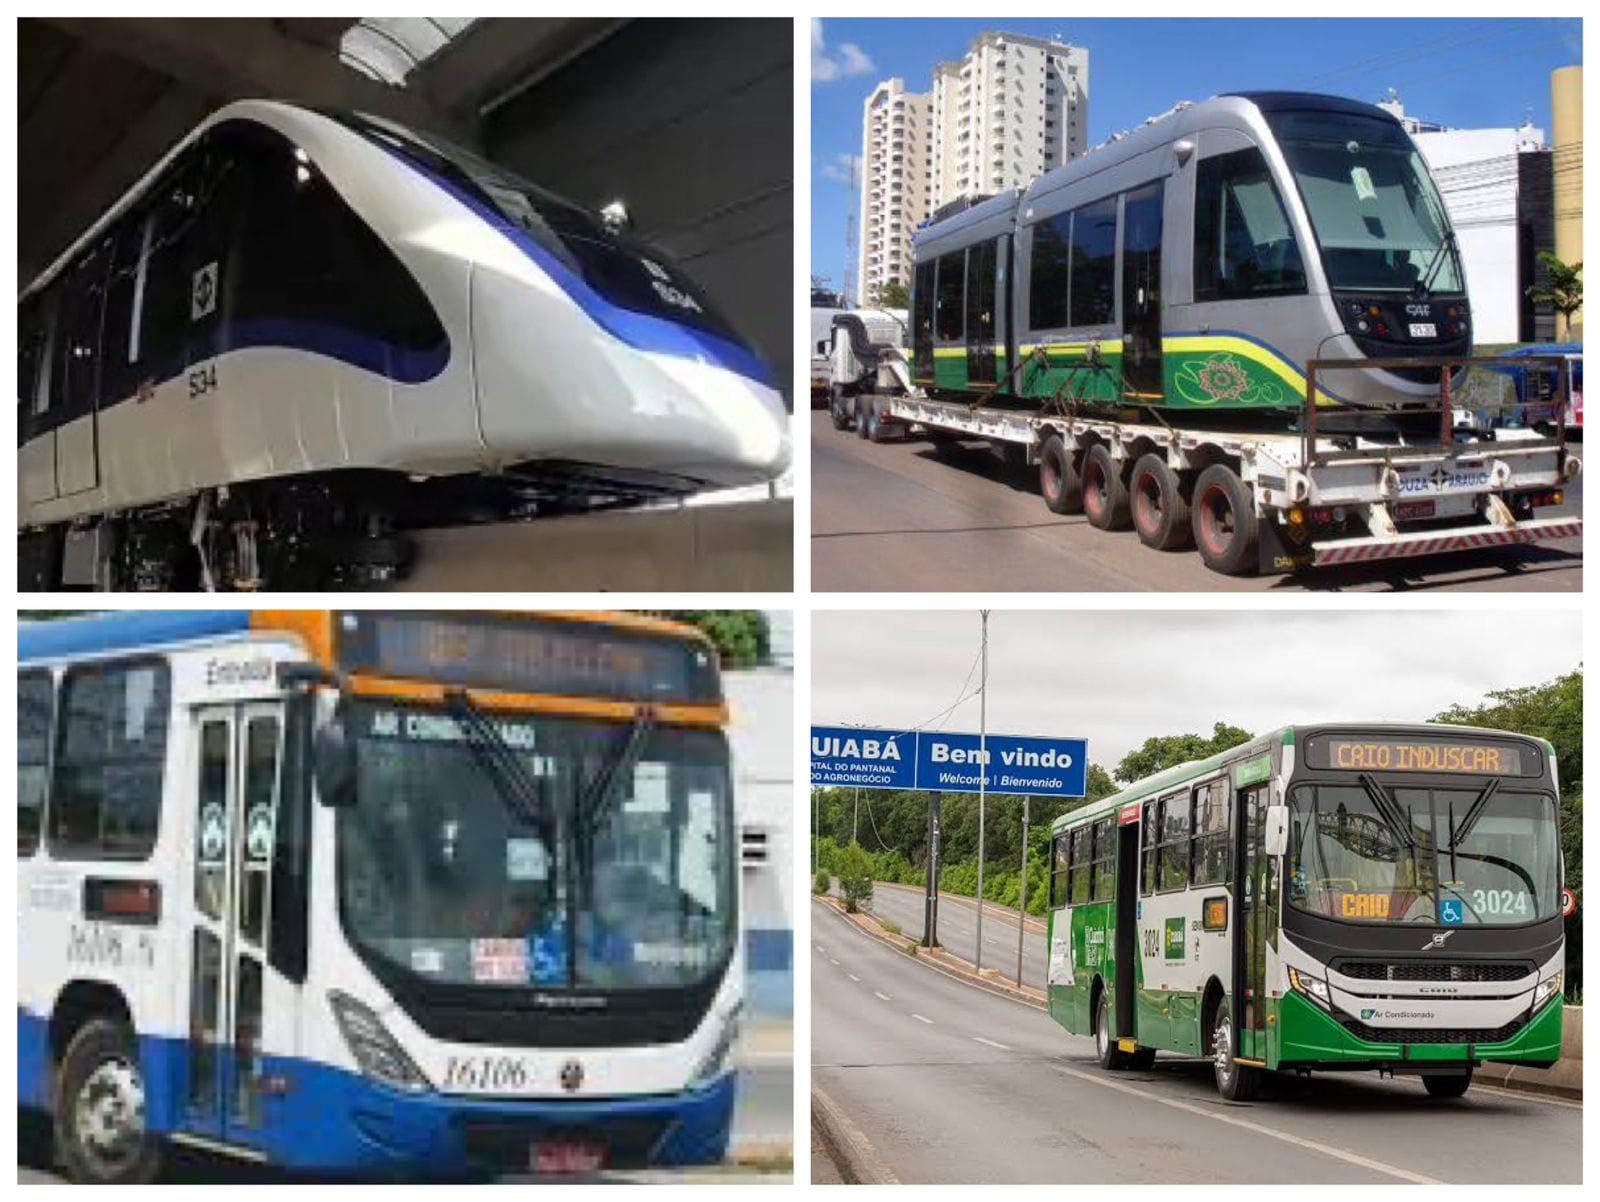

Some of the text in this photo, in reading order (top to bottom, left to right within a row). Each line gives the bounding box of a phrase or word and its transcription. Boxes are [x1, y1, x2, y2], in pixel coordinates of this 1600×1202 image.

[189, 364, 217, 399] S34
[834, 763, 848, 771] DO
[850, 763, 897, 774] PANTANAL
[931, 743, 1073, 769] Bem vindo
[1337, 744, 1500, 771] CAIO INDUSCAR
[823, 772, 891, 784] AGRONEGÓCIO
[939, 772, 1063, 789] Welcome Bienvenido
[1341, 894, 1390, 917] CAIO
[1473, 889, 1527, 915] 3024
[1144, 928, 1159, 958] 3024
